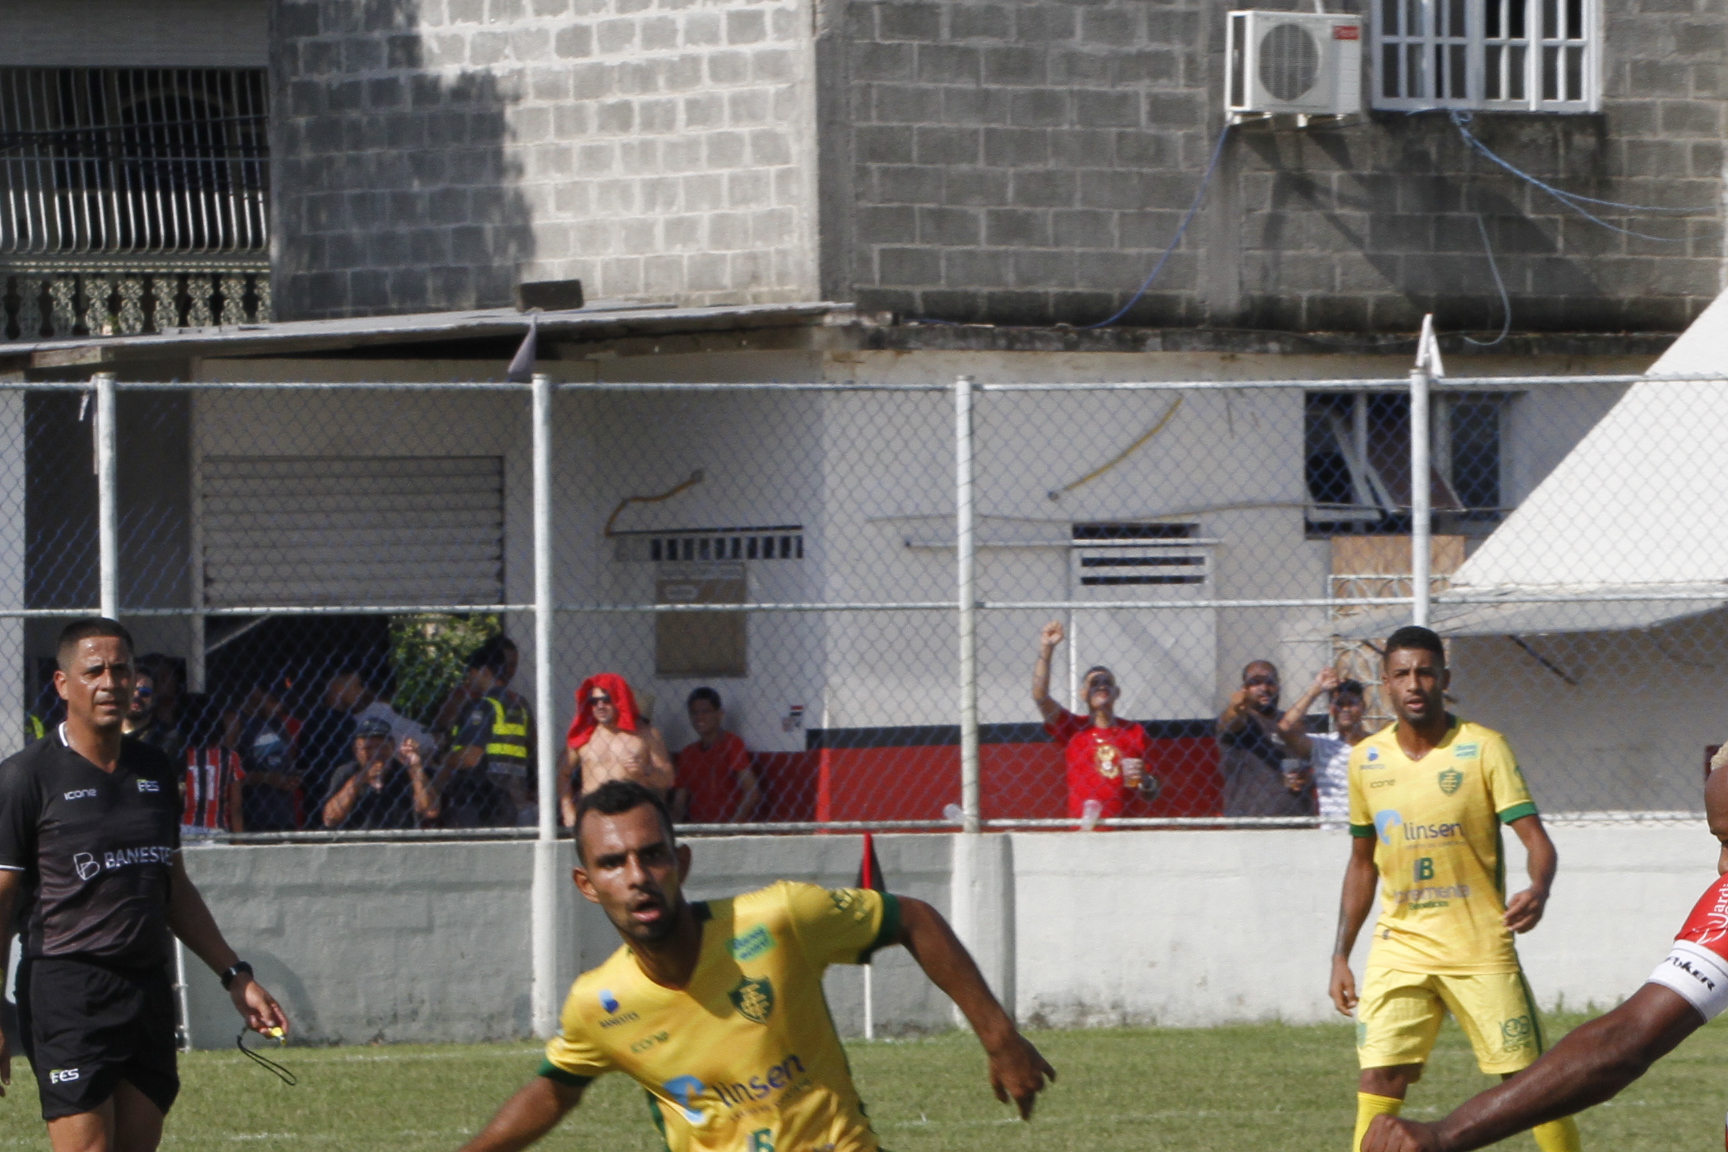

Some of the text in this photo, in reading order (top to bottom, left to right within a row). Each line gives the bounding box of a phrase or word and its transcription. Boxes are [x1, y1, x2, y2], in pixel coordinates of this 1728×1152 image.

[136, 778, 160, 793] FES
[1403, 822, 1465, 841] linsen
[104, 846, 173, 869] BANESTE
[49, 1067, 80, 1084] FES
